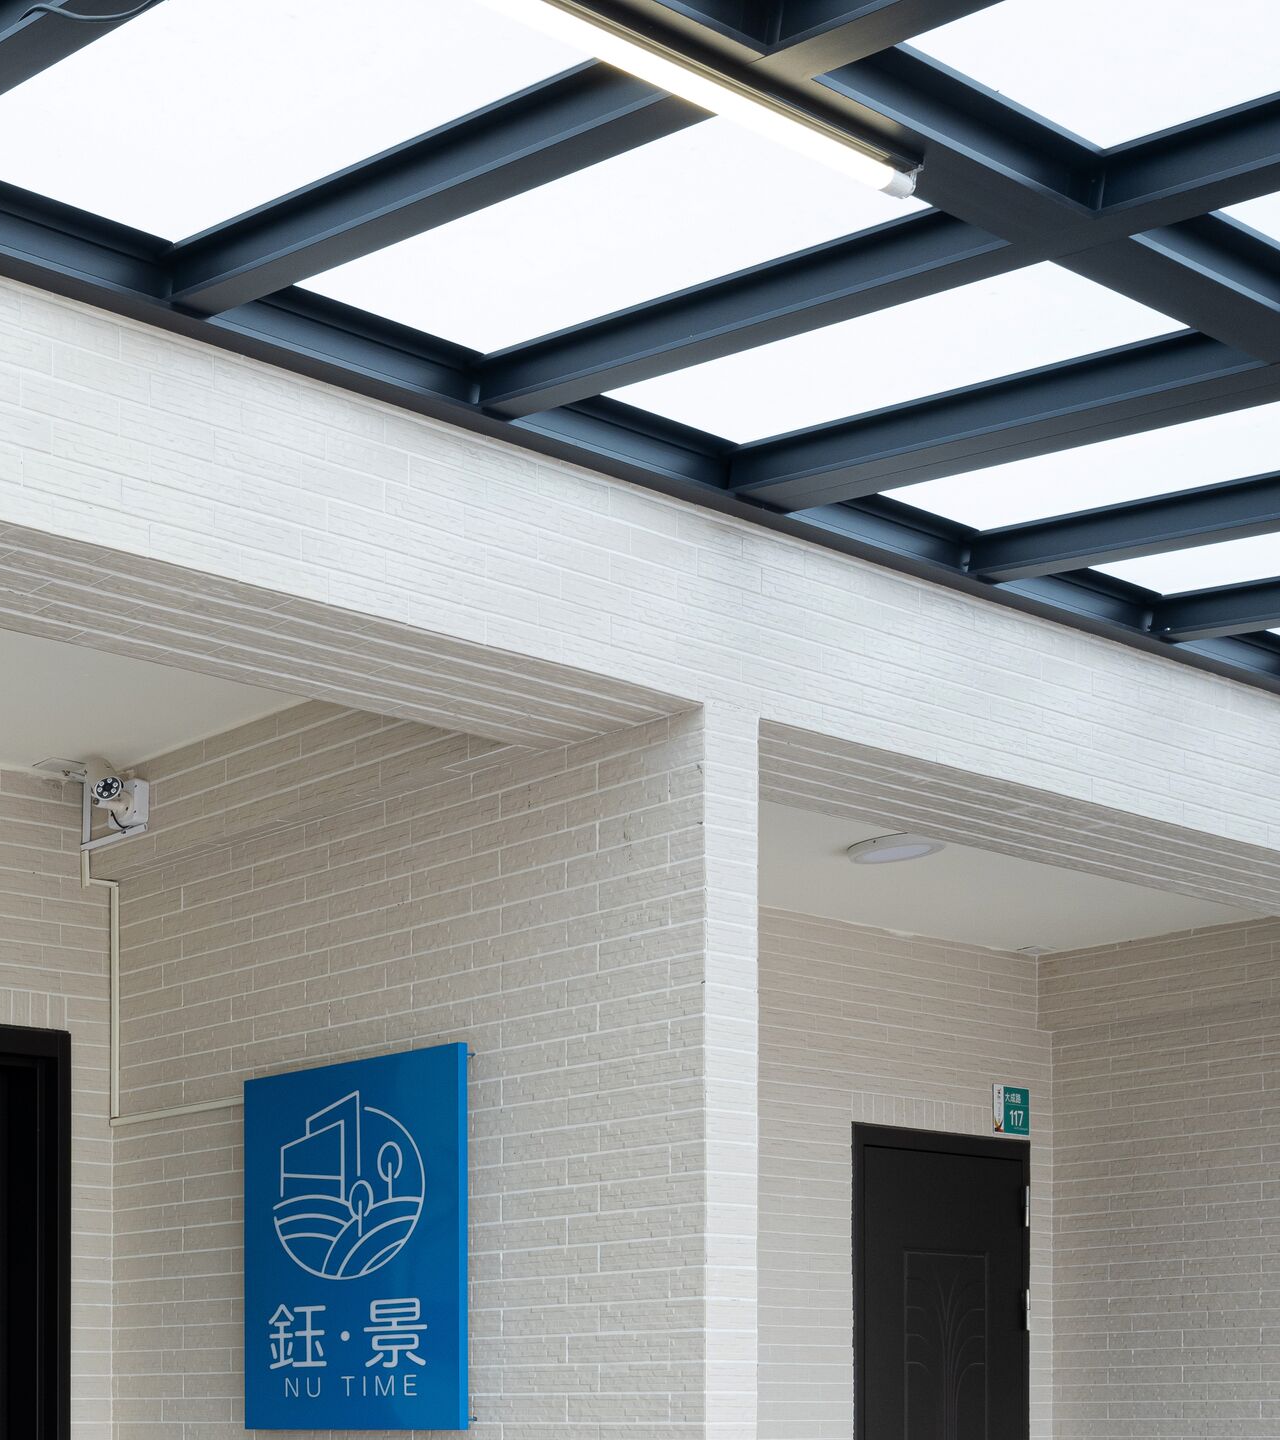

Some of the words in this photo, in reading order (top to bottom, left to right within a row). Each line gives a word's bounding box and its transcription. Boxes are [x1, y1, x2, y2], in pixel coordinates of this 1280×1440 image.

[1009, 1110, 1024, 1127] 117
[284, 1376, 321, 1398] NU
[340, 1374, 418, 1397] TIME
